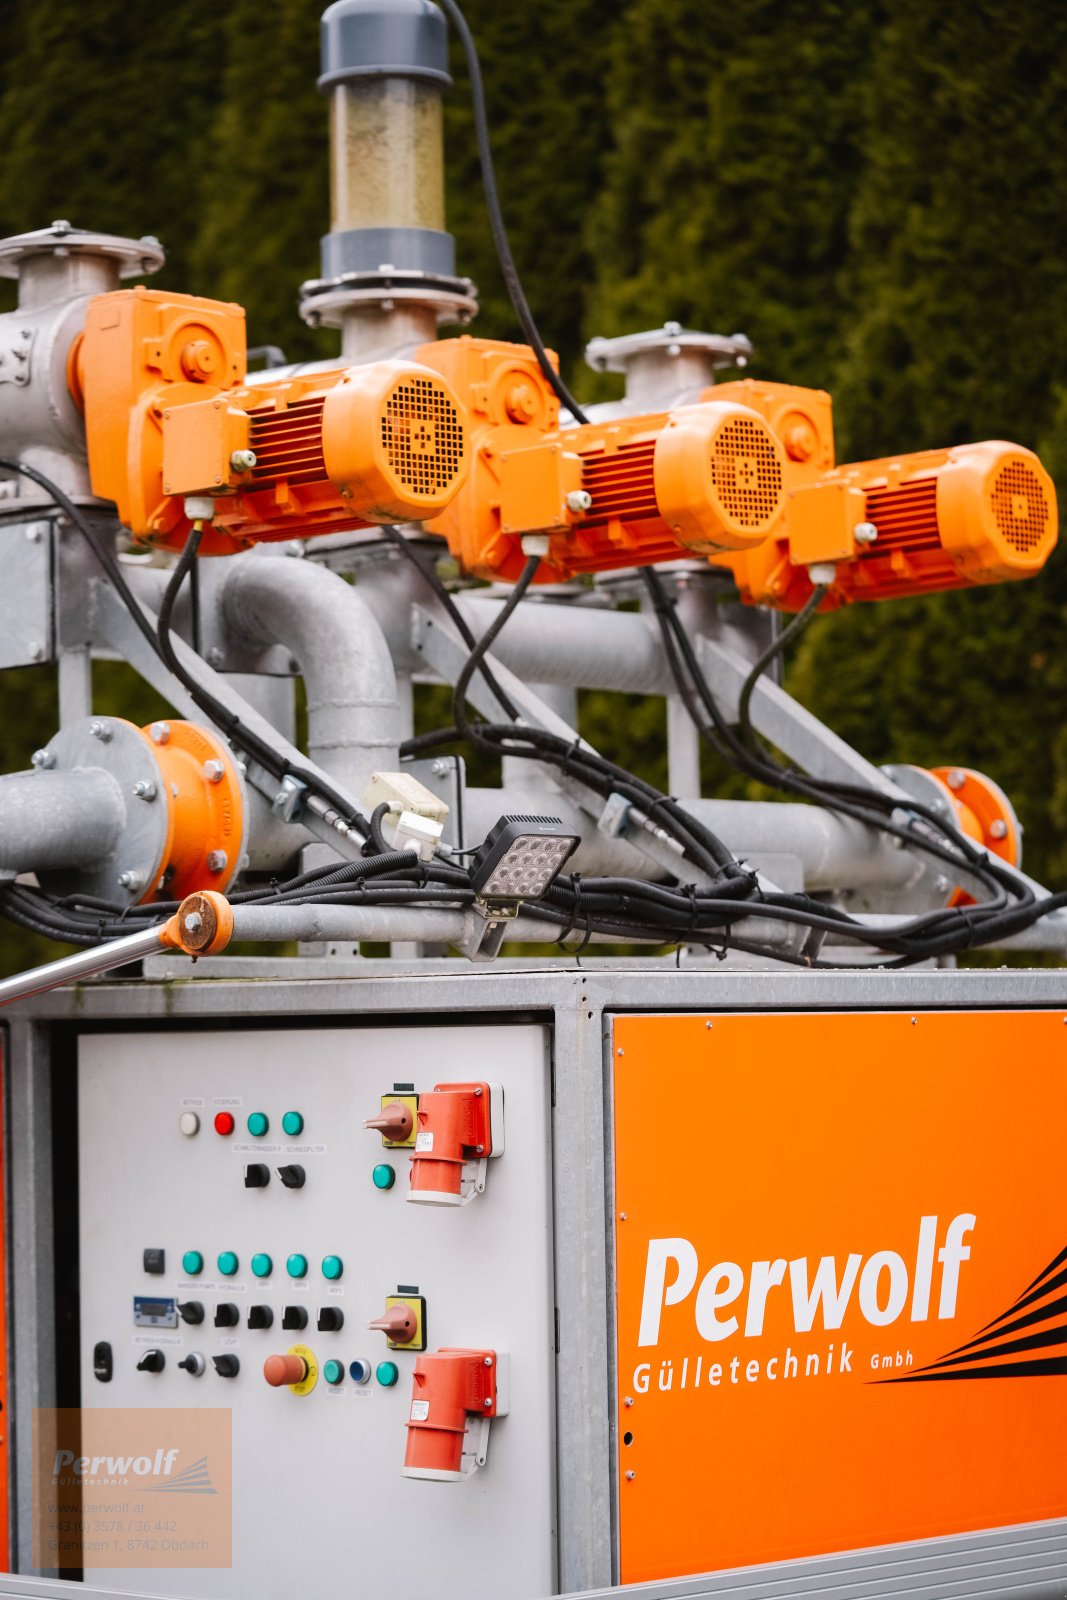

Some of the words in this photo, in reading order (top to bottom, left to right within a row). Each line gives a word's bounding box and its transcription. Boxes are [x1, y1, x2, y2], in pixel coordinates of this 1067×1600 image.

[637, 1212, 977, 1348] Perwolf
[632, 1342, 854, 1394] Gülletechnik
[869, 1349, 914, 1370] Gmbh
